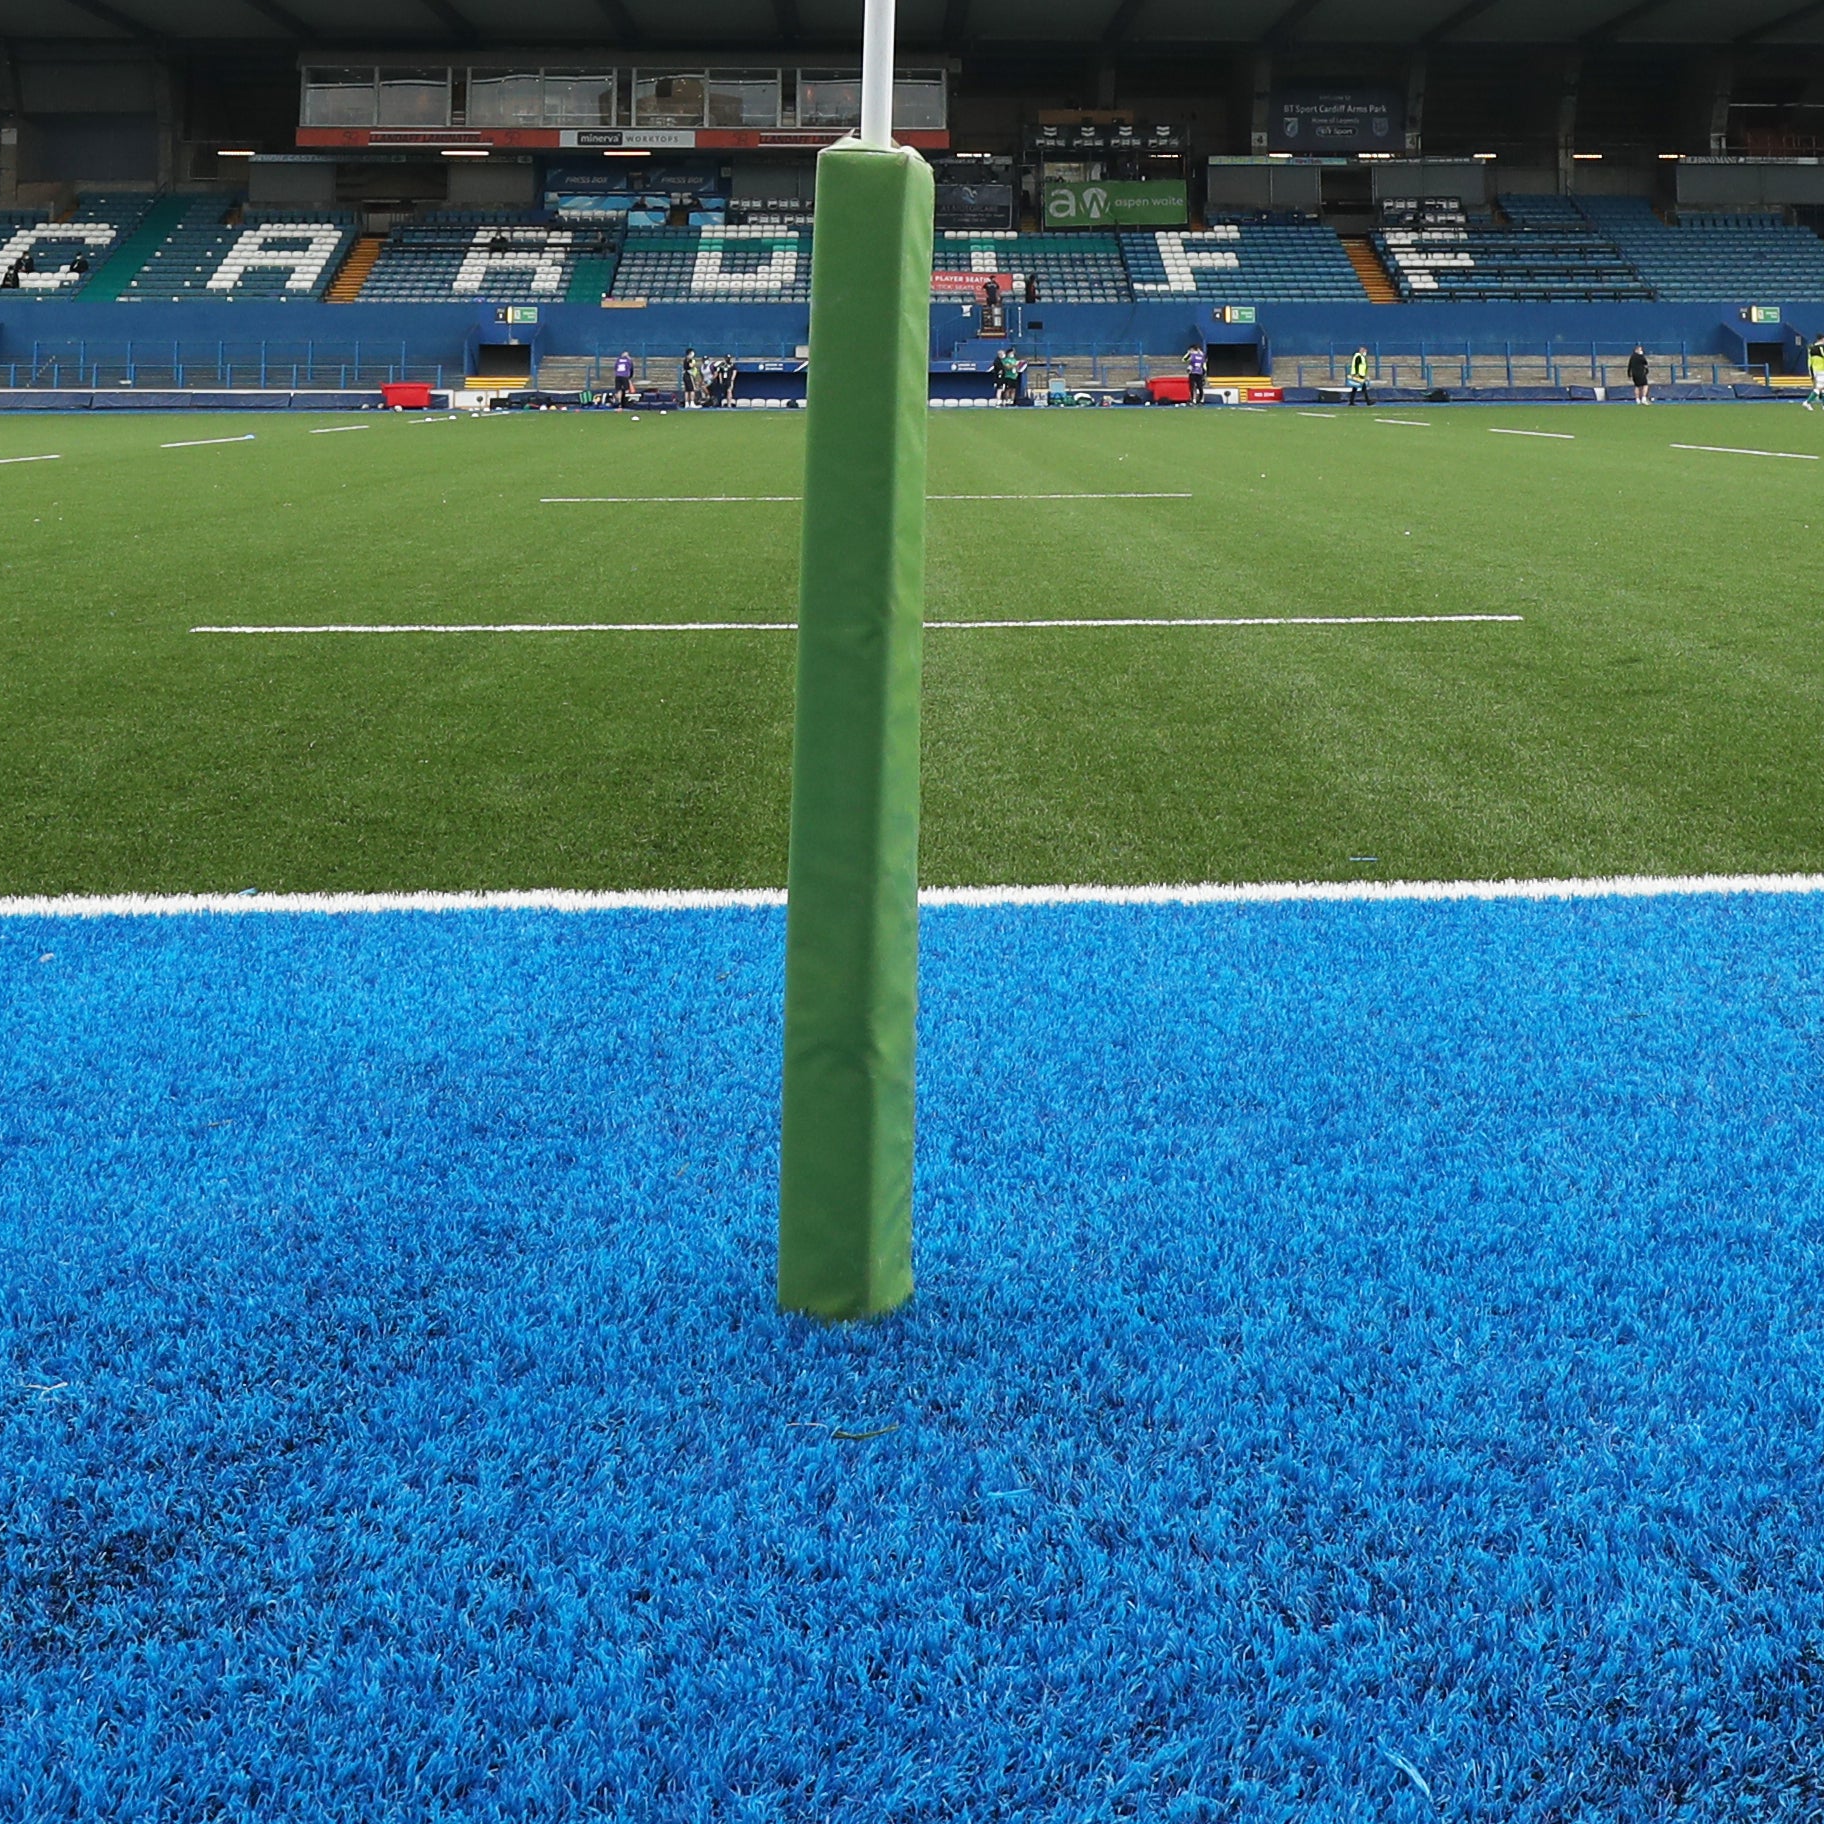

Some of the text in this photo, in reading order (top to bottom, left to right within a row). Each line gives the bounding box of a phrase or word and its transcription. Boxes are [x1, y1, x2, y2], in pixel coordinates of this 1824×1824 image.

[1295, 104, 1318, 114] Sport
[1347, 104, 1368, 113] Arms
[1369, 104, 1387, 113] Park
[580, 133, 680, 144] minerva WORKTOPS
[1114, 197, 1150, 208] aspen
[1151, 196, 1184, 207] waite
